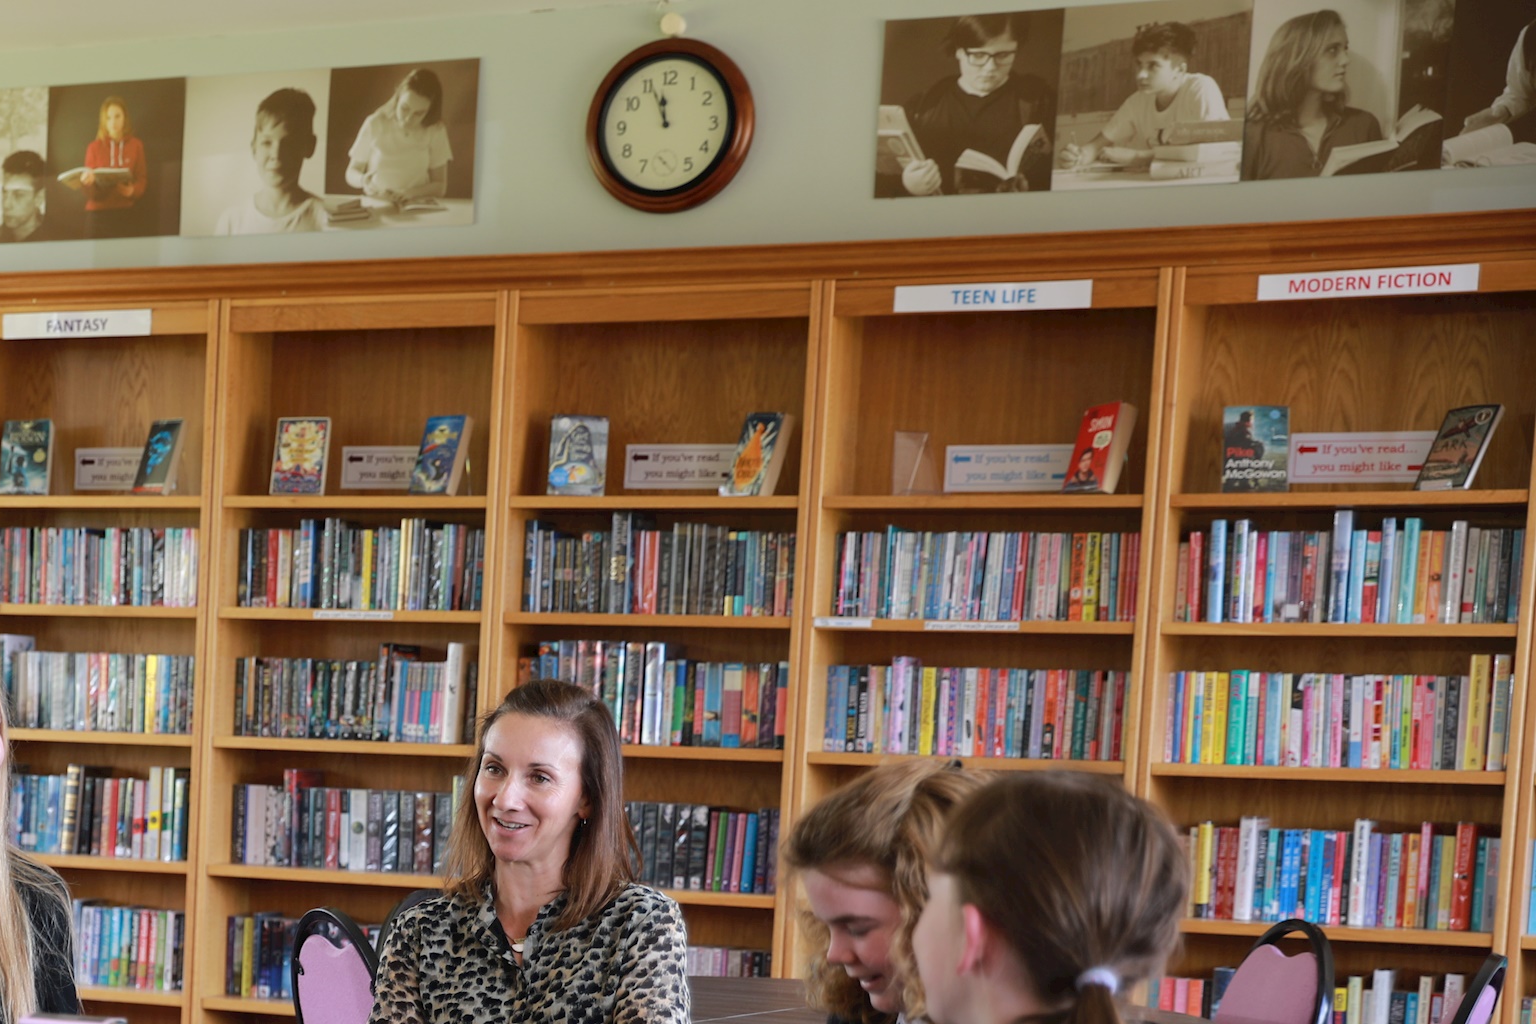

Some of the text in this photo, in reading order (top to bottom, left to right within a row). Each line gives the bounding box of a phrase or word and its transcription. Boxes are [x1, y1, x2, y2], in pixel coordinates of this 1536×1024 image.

[663, 70, 678, 85] 12
[690, 77, 696, 91] 1
[643, 79, 654, 93] 11
[626, 96, 640, 111] 10
[702, 91, 713, 106] 2
[616, 121, 626, 135] 9
[708, 116, 719, 131] 3
[622, 143, 632, 158] 8
[699, 140, 709, 153] 4
[639, 159, 648, 173] 7
[683, 157, 693, 172] 5
[1288, 272, 1452, 293] MODERN FICTION
[951, 288, 1037, 305] TEEN LIFE
[46, 318, 109, 333] FANTASY
[1226, 446, 1255, 457] Pike
[1322, 444, 1331, 454] If
[1333, 444, 1367, 457] you've
[651, 453, 661, 463] If
[662, 453, 694, 465] you've
[974, 454, 983, 464] If
[985, 454, 1021, 466] you've
[1226, 458, 1275, 471] Anthony
[644, 468, 717, 481] you might like
[1225, 468, 1287, 480] McGowan
[1312, 461, 1403, 475] you might like
[966, 470, 1047, 483] you might like
